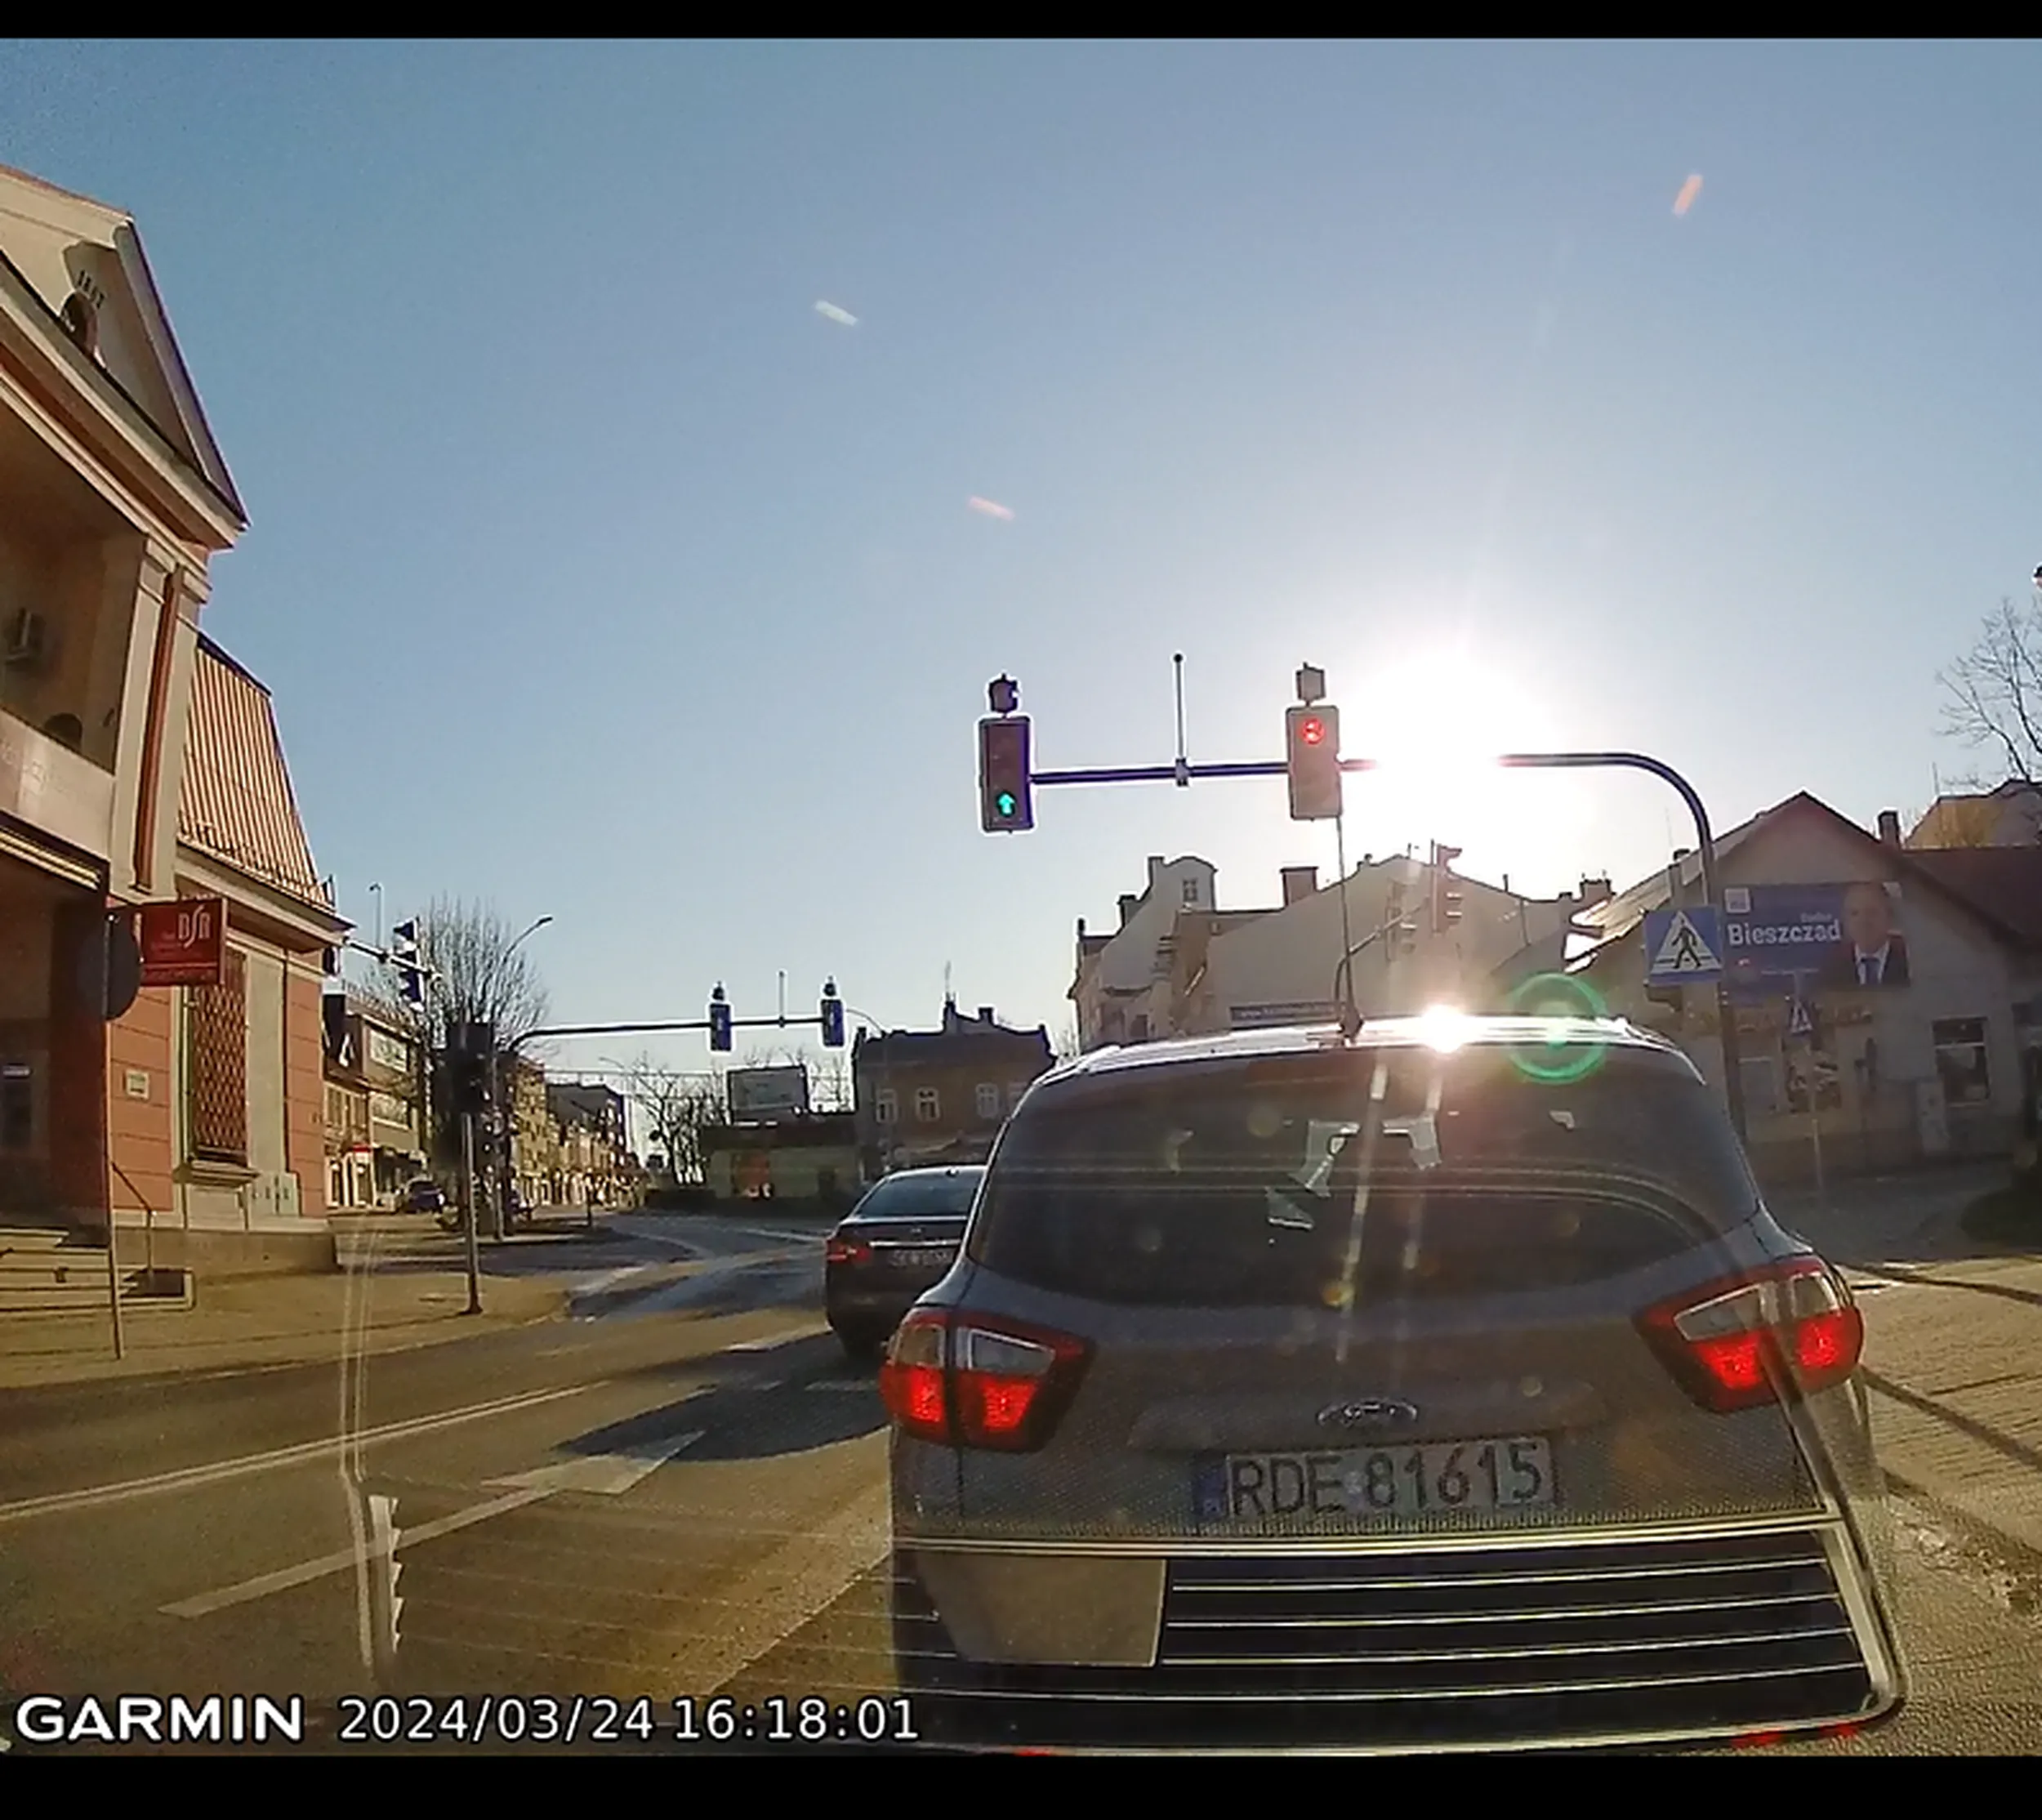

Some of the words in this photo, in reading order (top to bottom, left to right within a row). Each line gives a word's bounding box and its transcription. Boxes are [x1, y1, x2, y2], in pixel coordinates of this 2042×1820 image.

[1727, 918, 1841, 946] Bieszczad
[1232, 1455, 1346, 1516] RDE
[1365, 1443, 1543, 1508] 81615
